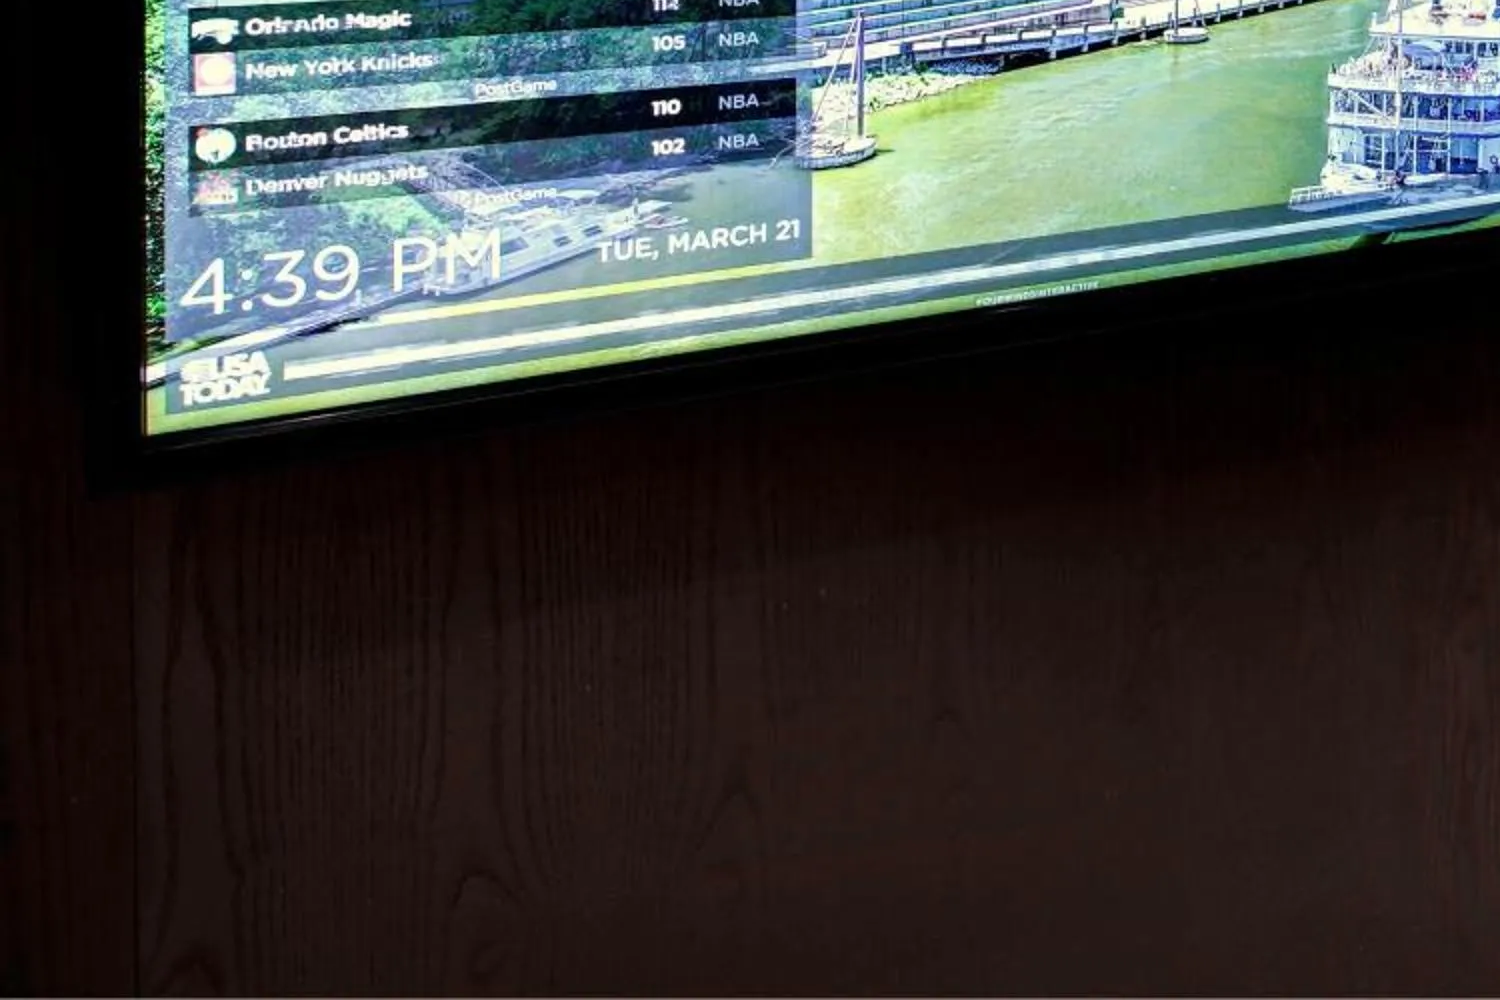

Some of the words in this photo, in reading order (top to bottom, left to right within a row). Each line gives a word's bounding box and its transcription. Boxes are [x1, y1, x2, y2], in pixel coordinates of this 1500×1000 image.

[652, 34, 686, 51] 105
[718, 32, 760, 47] NBA
[246, 60, 298, 80] New
[304, 56, 355, 75] York
[361, 51, 434, 72] Knicks
[652, 99, 681, 116] 110
[718, 94, 760, 110] NBA
[652, 137, 686, 155] 102
[718, 134, 760, 150] NBA
[600, 237, 659, 262] TUE,
[668, 223, 767, 254] MARCH
[775, 219, 801, 241] 21
[179, 244, 361, 315] 4:39
[392, 227, 502, 293] PM
